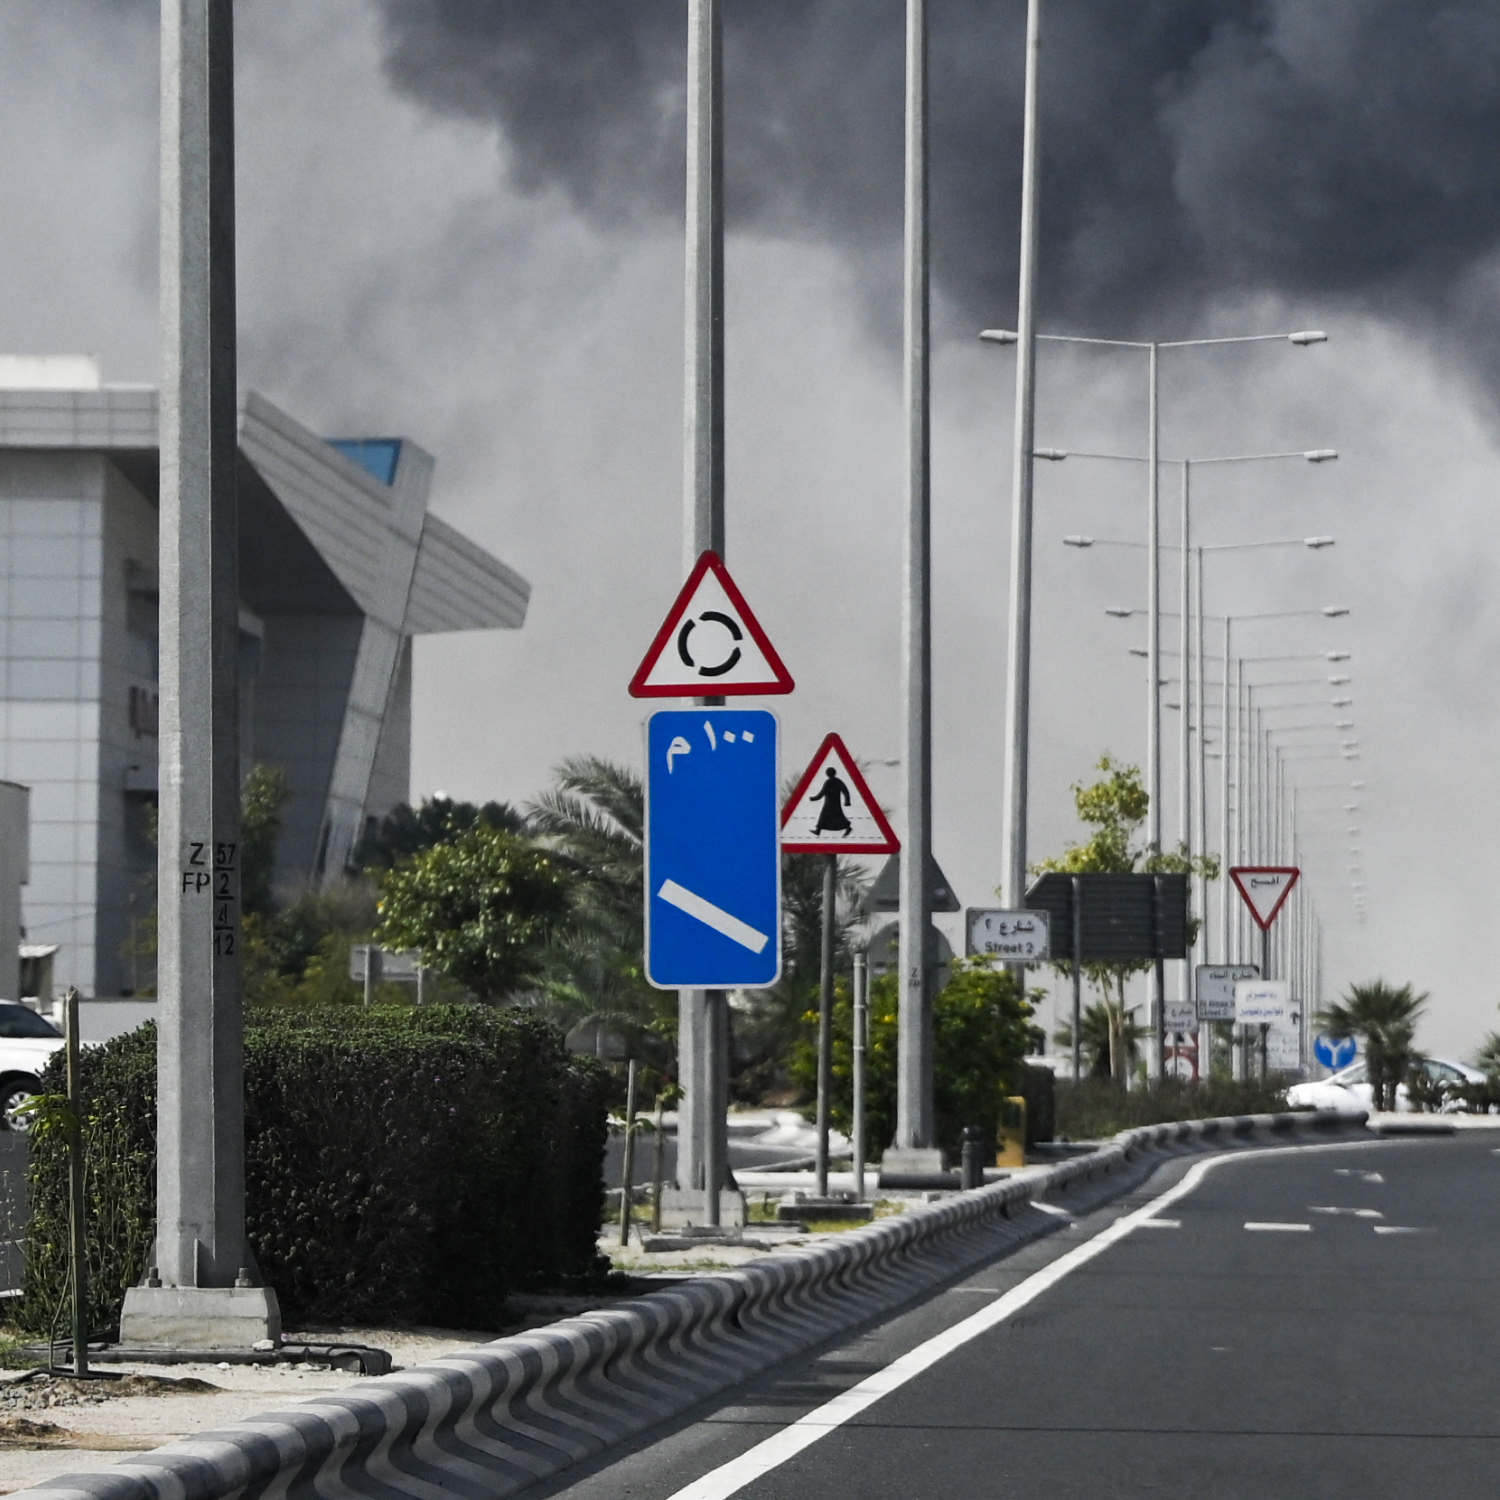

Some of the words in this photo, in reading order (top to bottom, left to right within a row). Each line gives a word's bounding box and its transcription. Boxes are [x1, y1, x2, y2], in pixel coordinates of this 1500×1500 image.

[703, 720, 754, 751] ١٠٠
[666, 736, 691, 774] م
[190, 842, 204, 866] Z
[217, 843, 236, 865] 57
[182, 872, 210, 893] FP
[219, 872, 229, 894] 2
[214, 934, 234, 956] 12
[985, 941, 1022, 953] Street
[1026, 941, 1034, 953] 2
